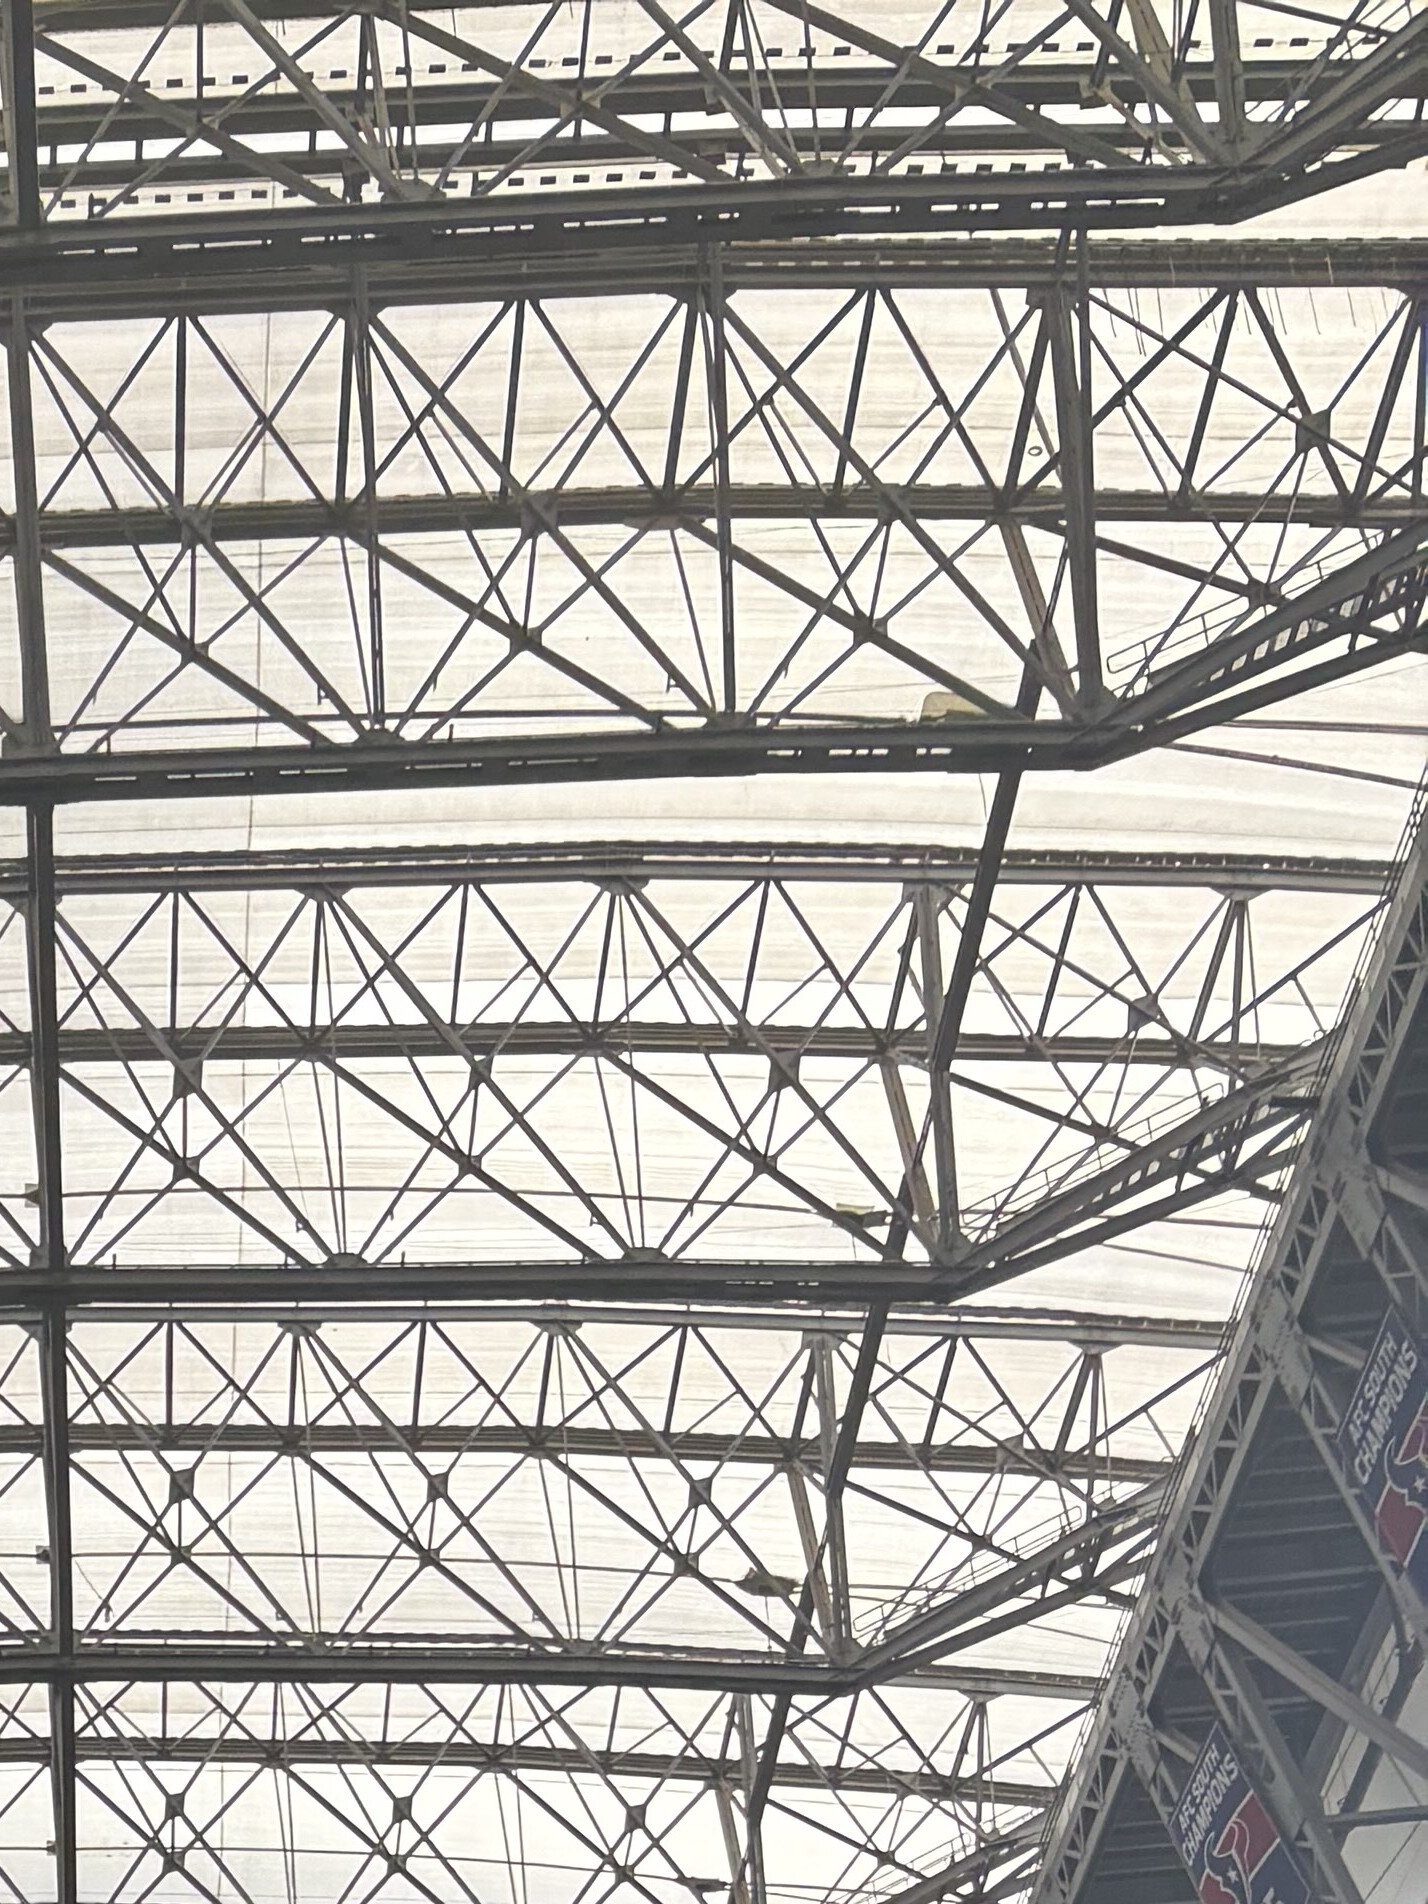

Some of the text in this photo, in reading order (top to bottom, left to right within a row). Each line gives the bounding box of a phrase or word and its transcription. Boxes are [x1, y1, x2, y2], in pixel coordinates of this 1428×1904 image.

[1354, 1339, 1418, 1486] CHAMPIONS
[1364, 1332, 1397, 1408] SOUTH
[1177, 1743, 1220, 1834] AFC SOUTH
[1181, 1753, 1240, 1867] CHAMPIONS
